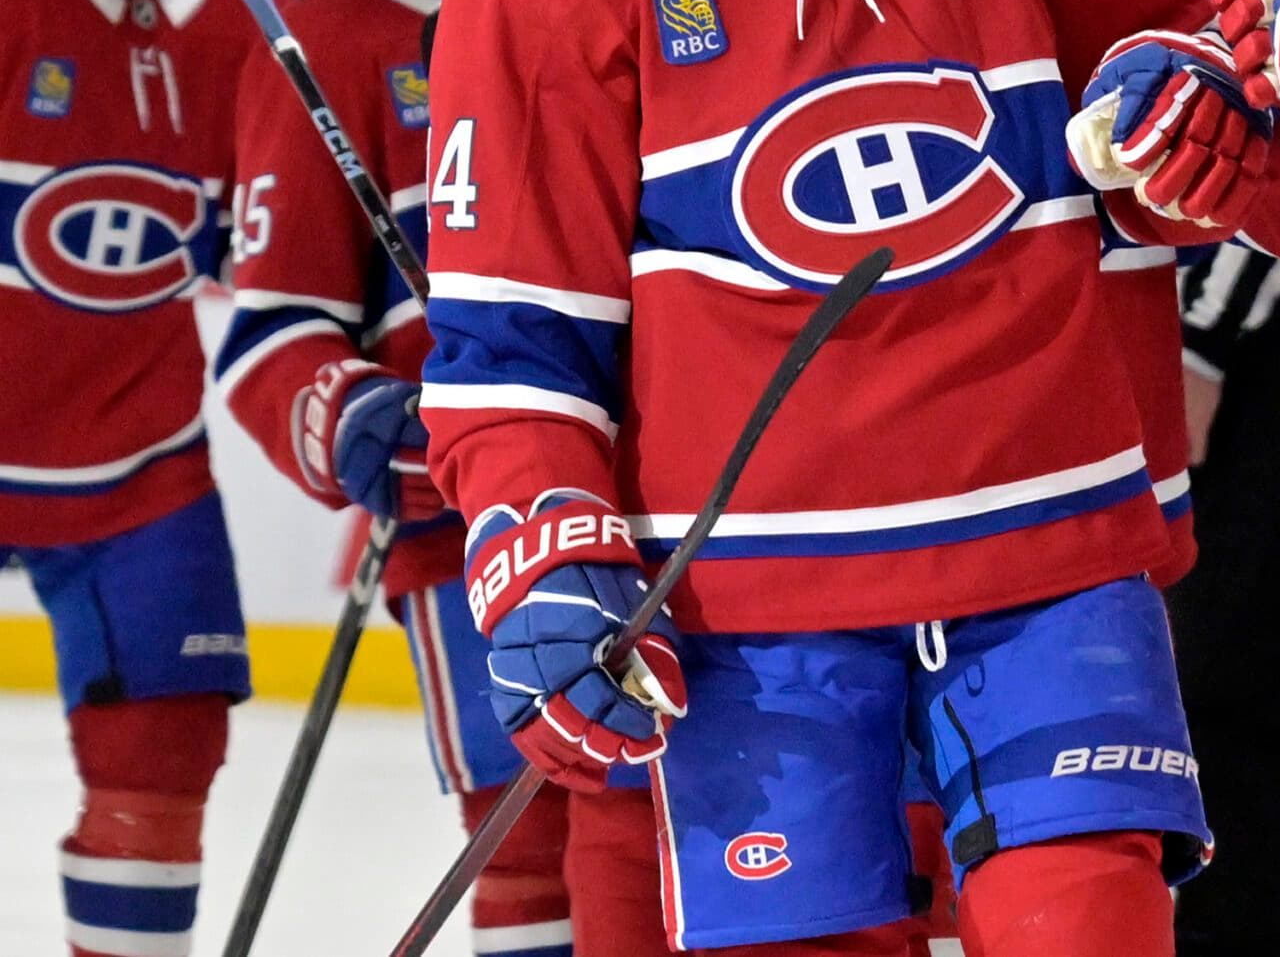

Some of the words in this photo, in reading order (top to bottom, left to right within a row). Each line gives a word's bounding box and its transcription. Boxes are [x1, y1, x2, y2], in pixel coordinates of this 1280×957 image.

[671, 31, 721, 58] RBC
[312, 106, 367, 179] CCM
[468, 514, 635, 633] BAUER
[1050, 745, 1200, 778] BAUER
